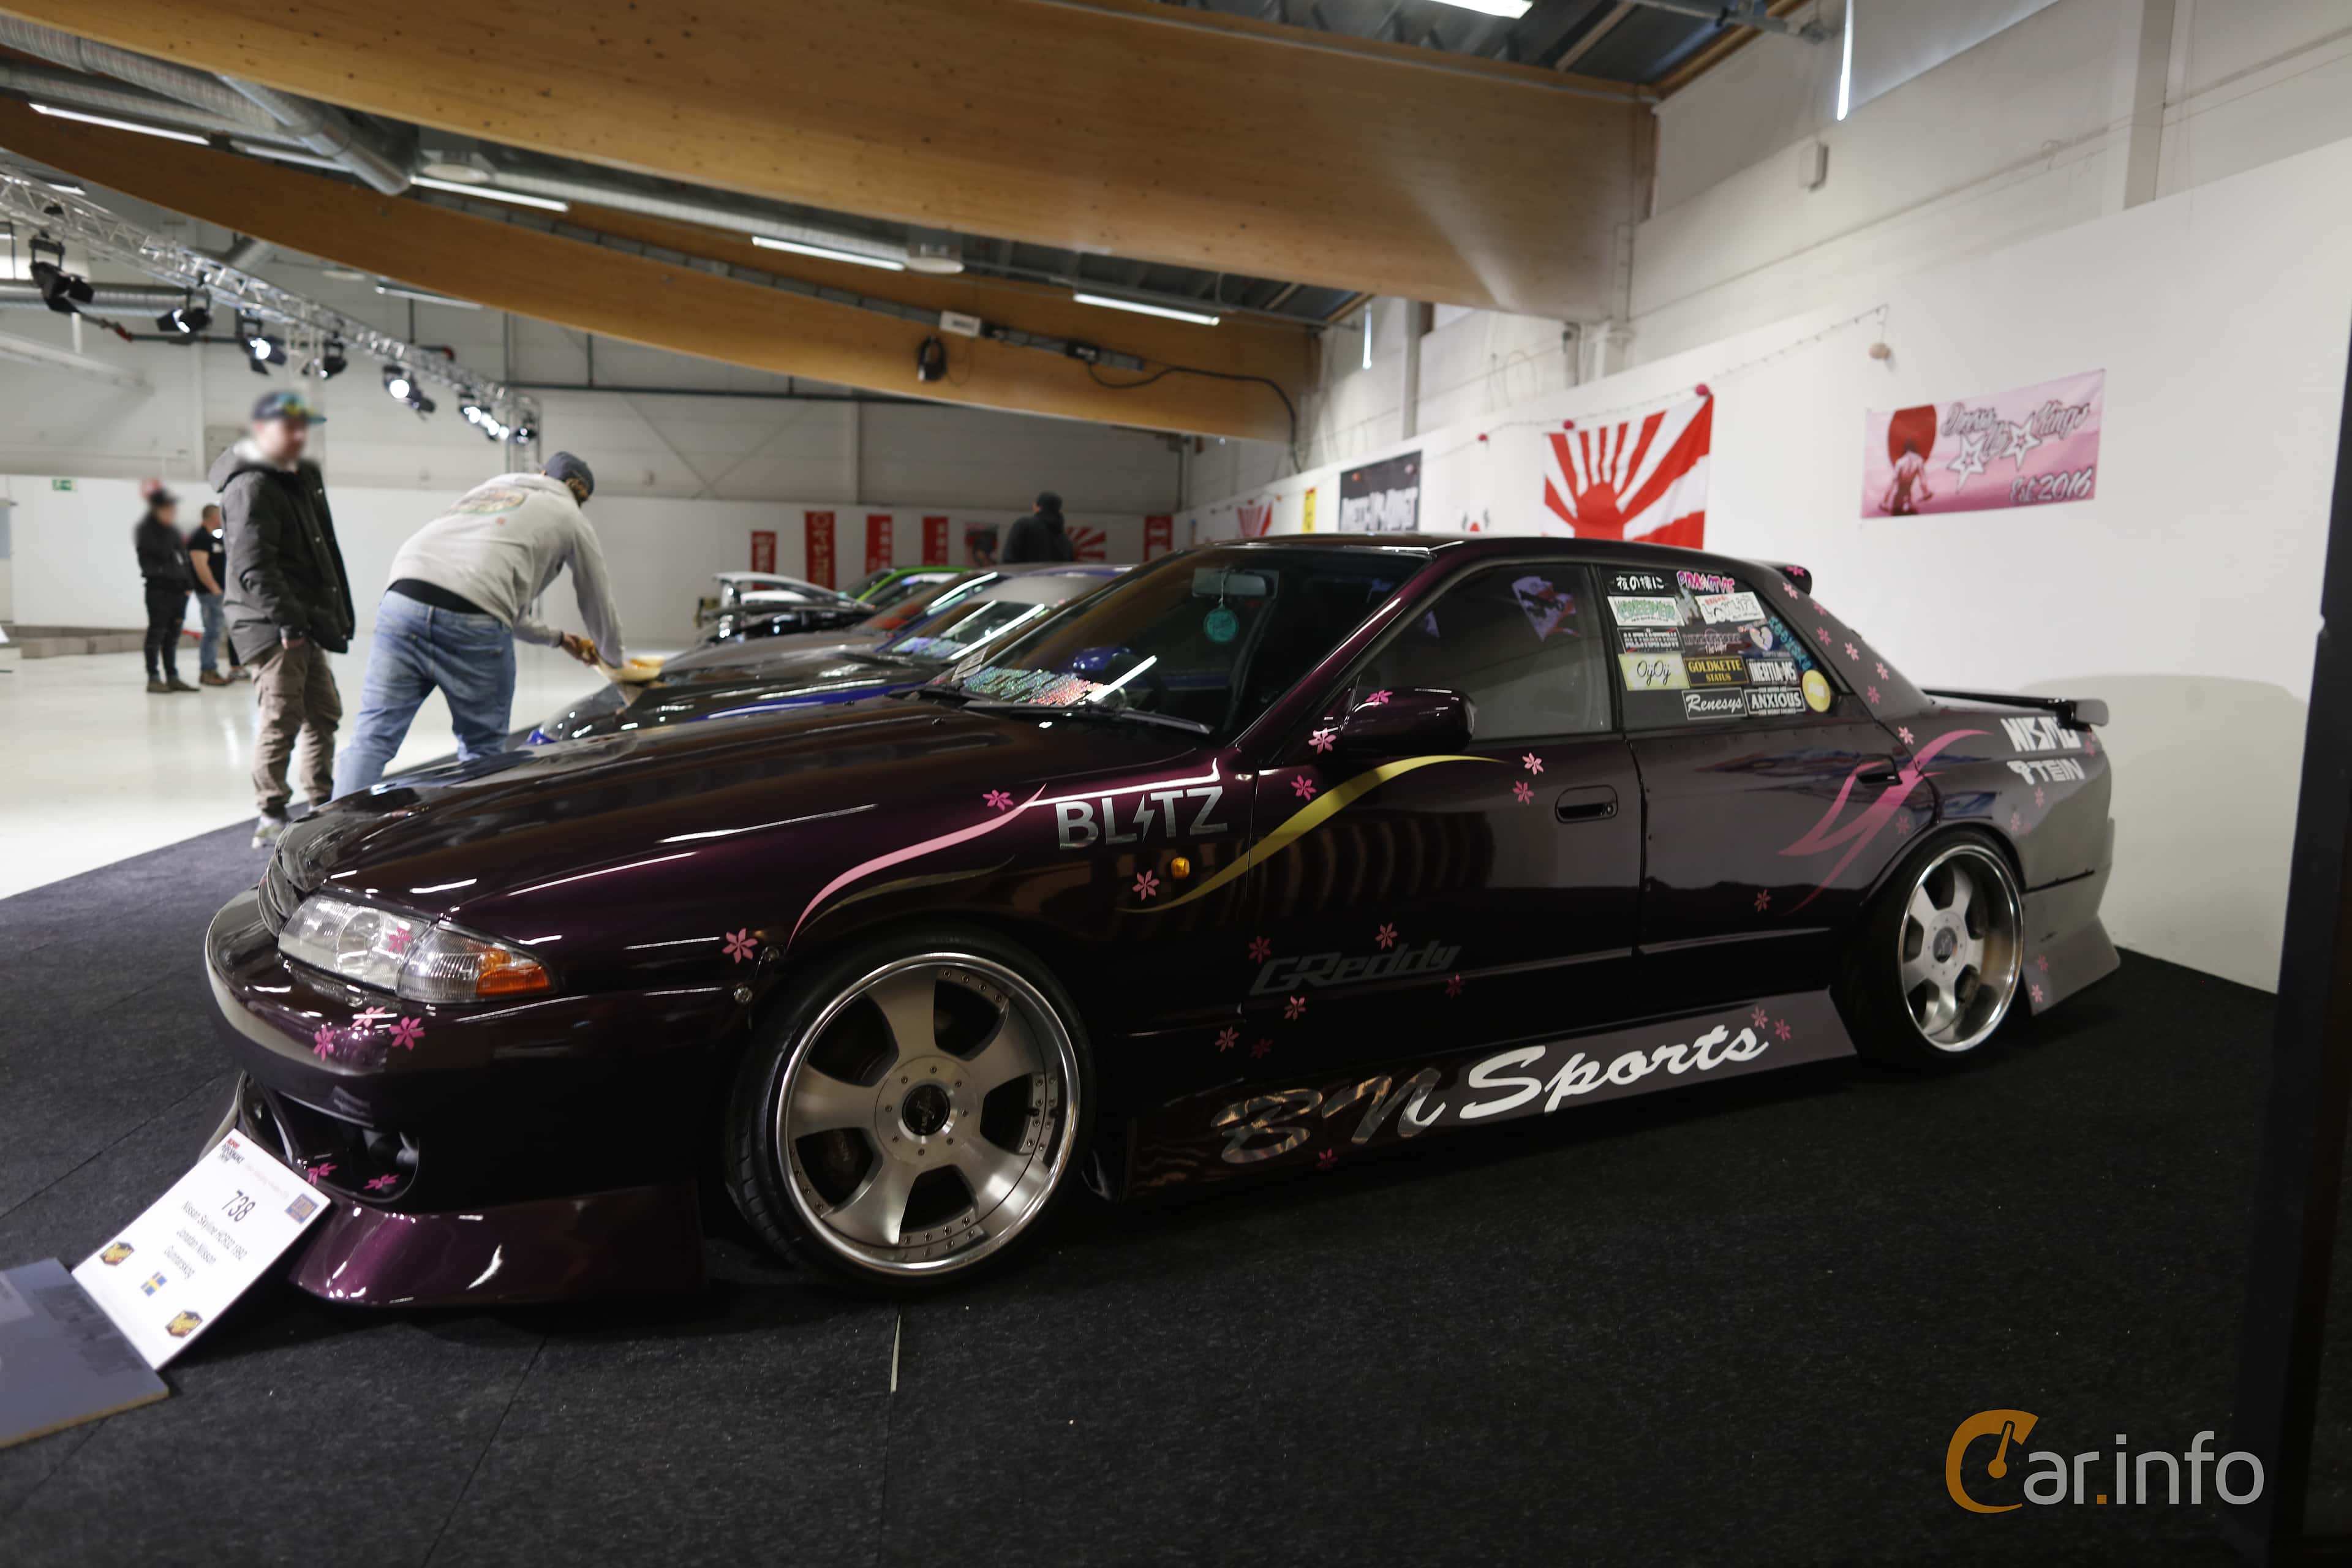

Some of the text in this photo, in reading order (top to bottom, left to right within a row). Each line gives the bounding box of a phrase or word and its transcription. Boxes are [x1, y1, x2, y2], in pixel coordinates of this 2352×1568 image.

[1687, 659, 1743, 673] GOLDKETTE
[1706, 673, 1732, 682] STATUS
[1686, 693, 1743, 714] Renesys
[1751, 692, 1802, 710] ANXIOUS
[1055, 785, 1228, 851] BLITZ
[1459, 1025, 1769, 1120] Sports
[222, 1189, 256, 1222] 738
